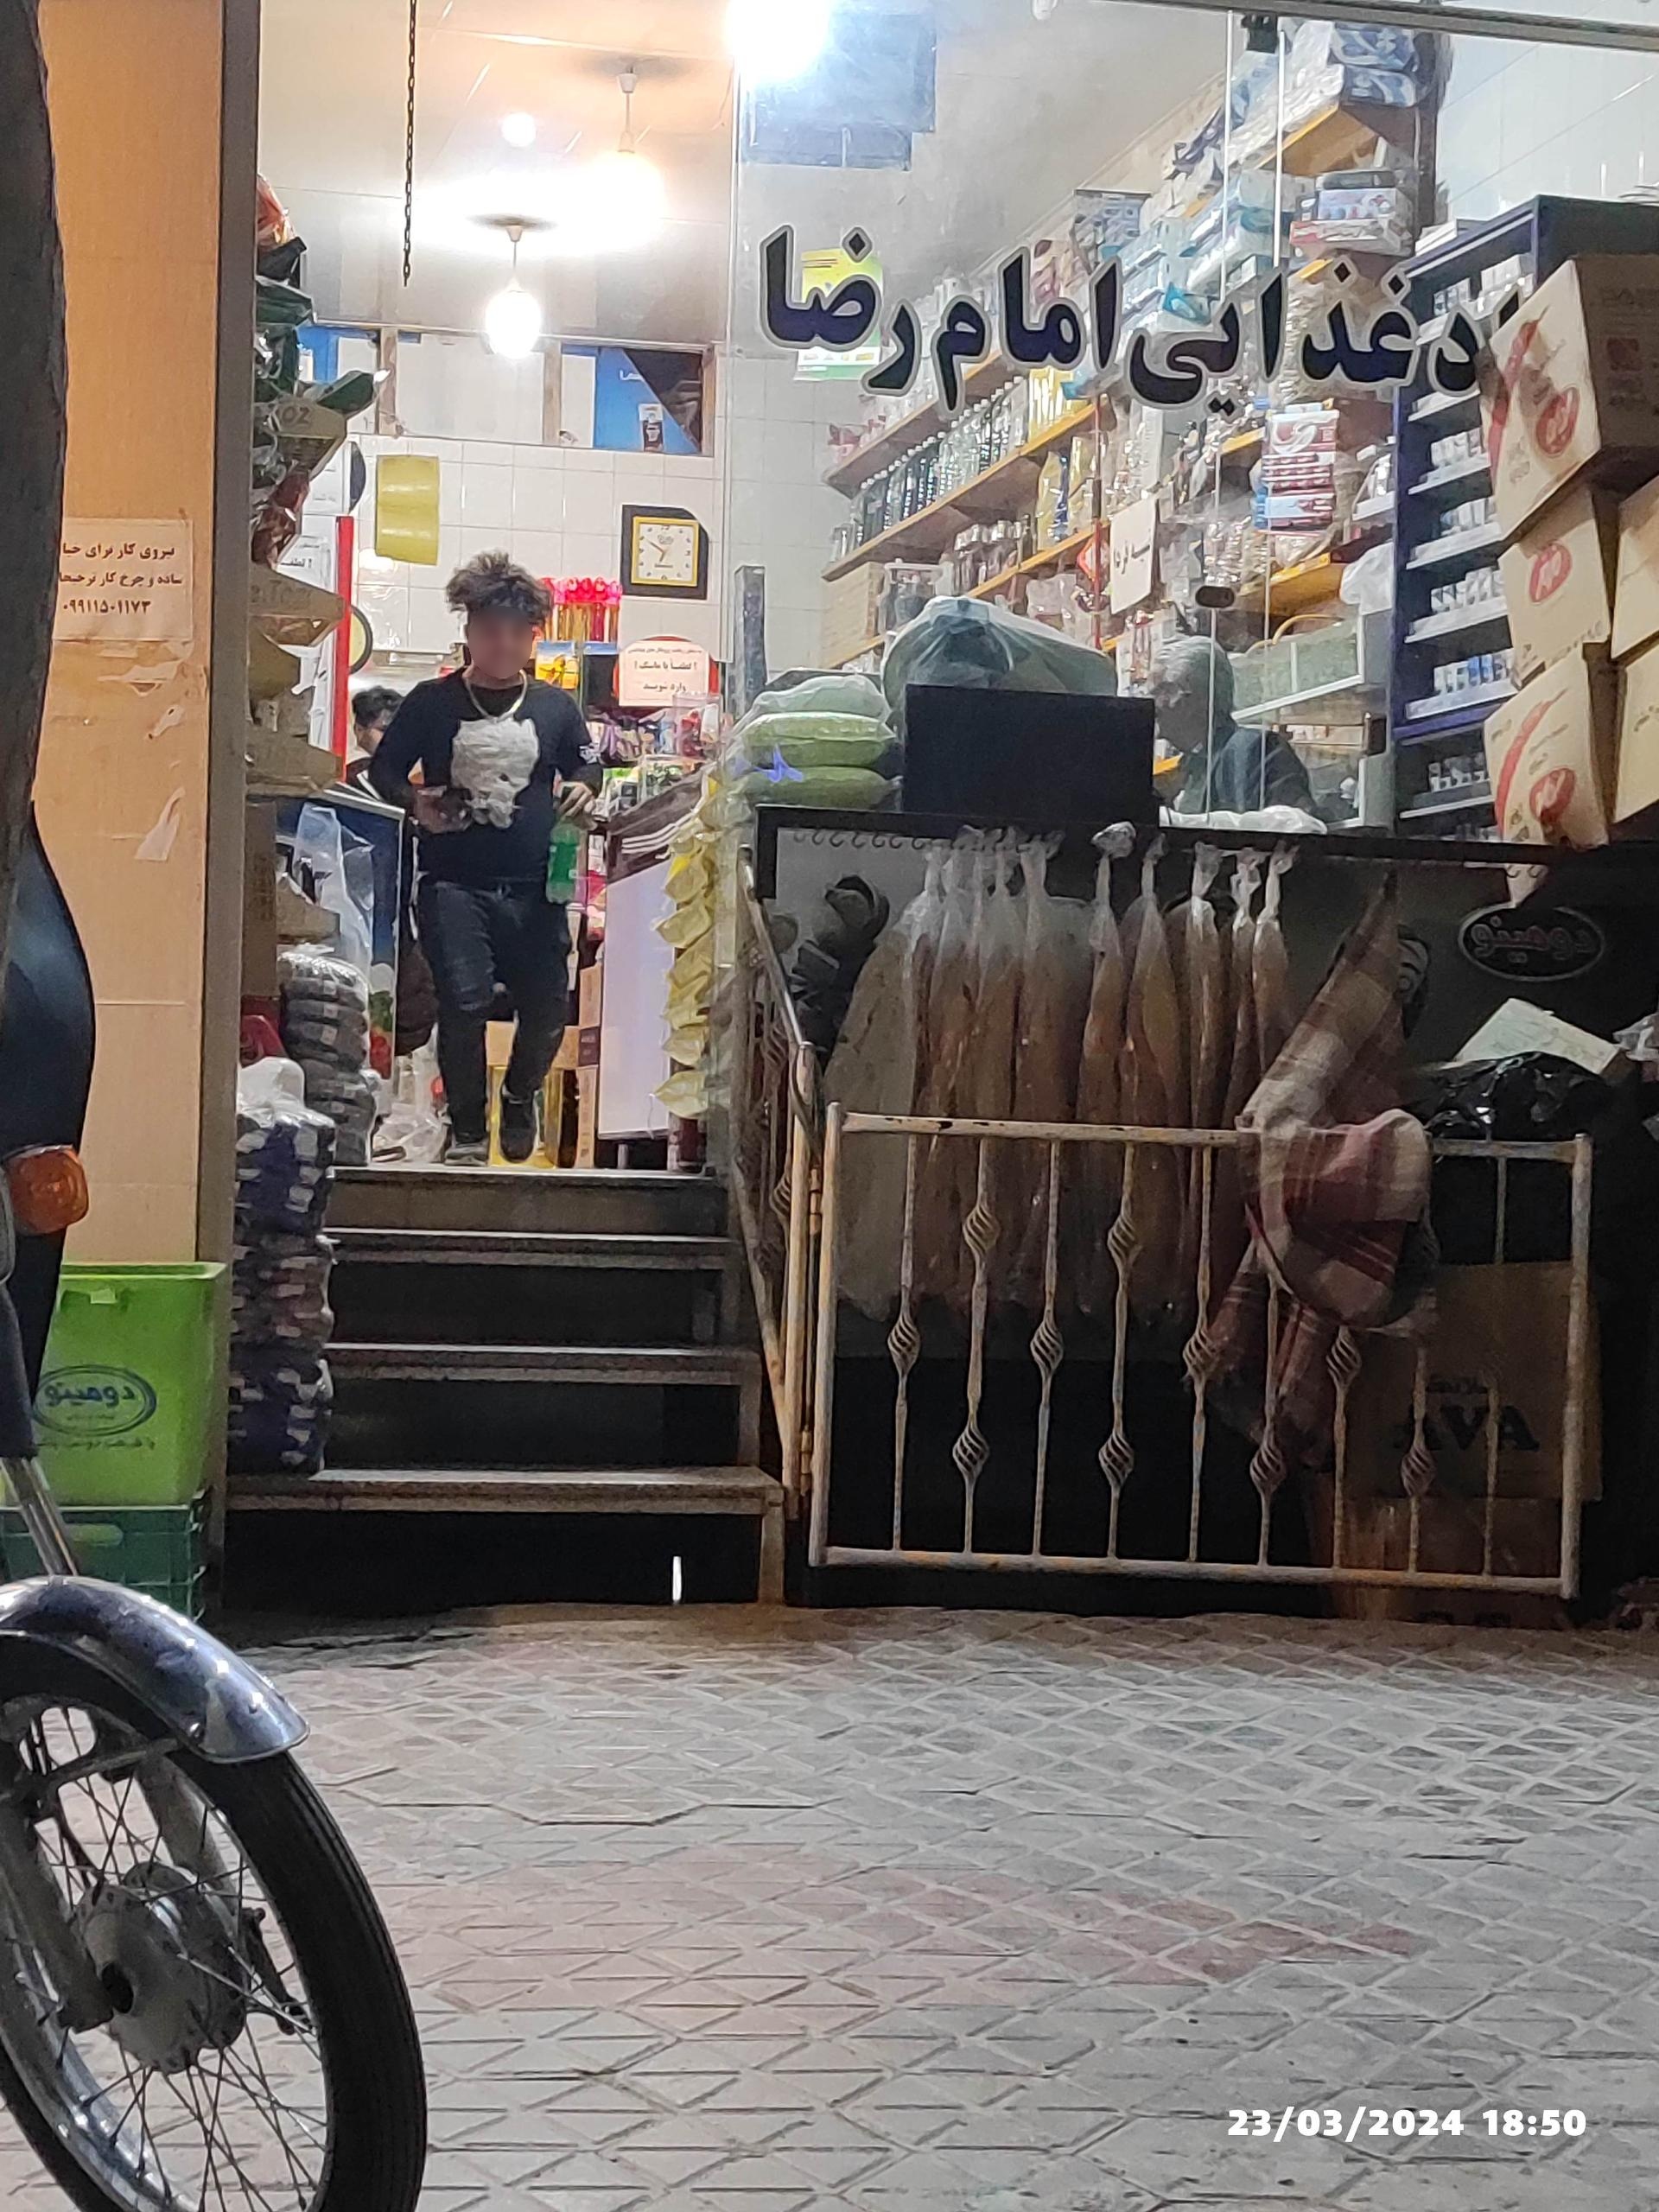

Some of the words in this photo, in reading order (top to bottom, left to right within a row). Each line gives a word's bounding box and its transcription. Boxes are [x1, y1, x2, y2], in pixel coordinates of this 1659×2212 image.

[761, 226, 919, 395] رضا
[933, 249, 1121, 415] امام
[1127, 258, 1417, 418] غذایی
[118, 543, 137, 559] کار
[1471, 914, 1597, 964] دومینو
[45, 1382, 136, 1408] دومینو
